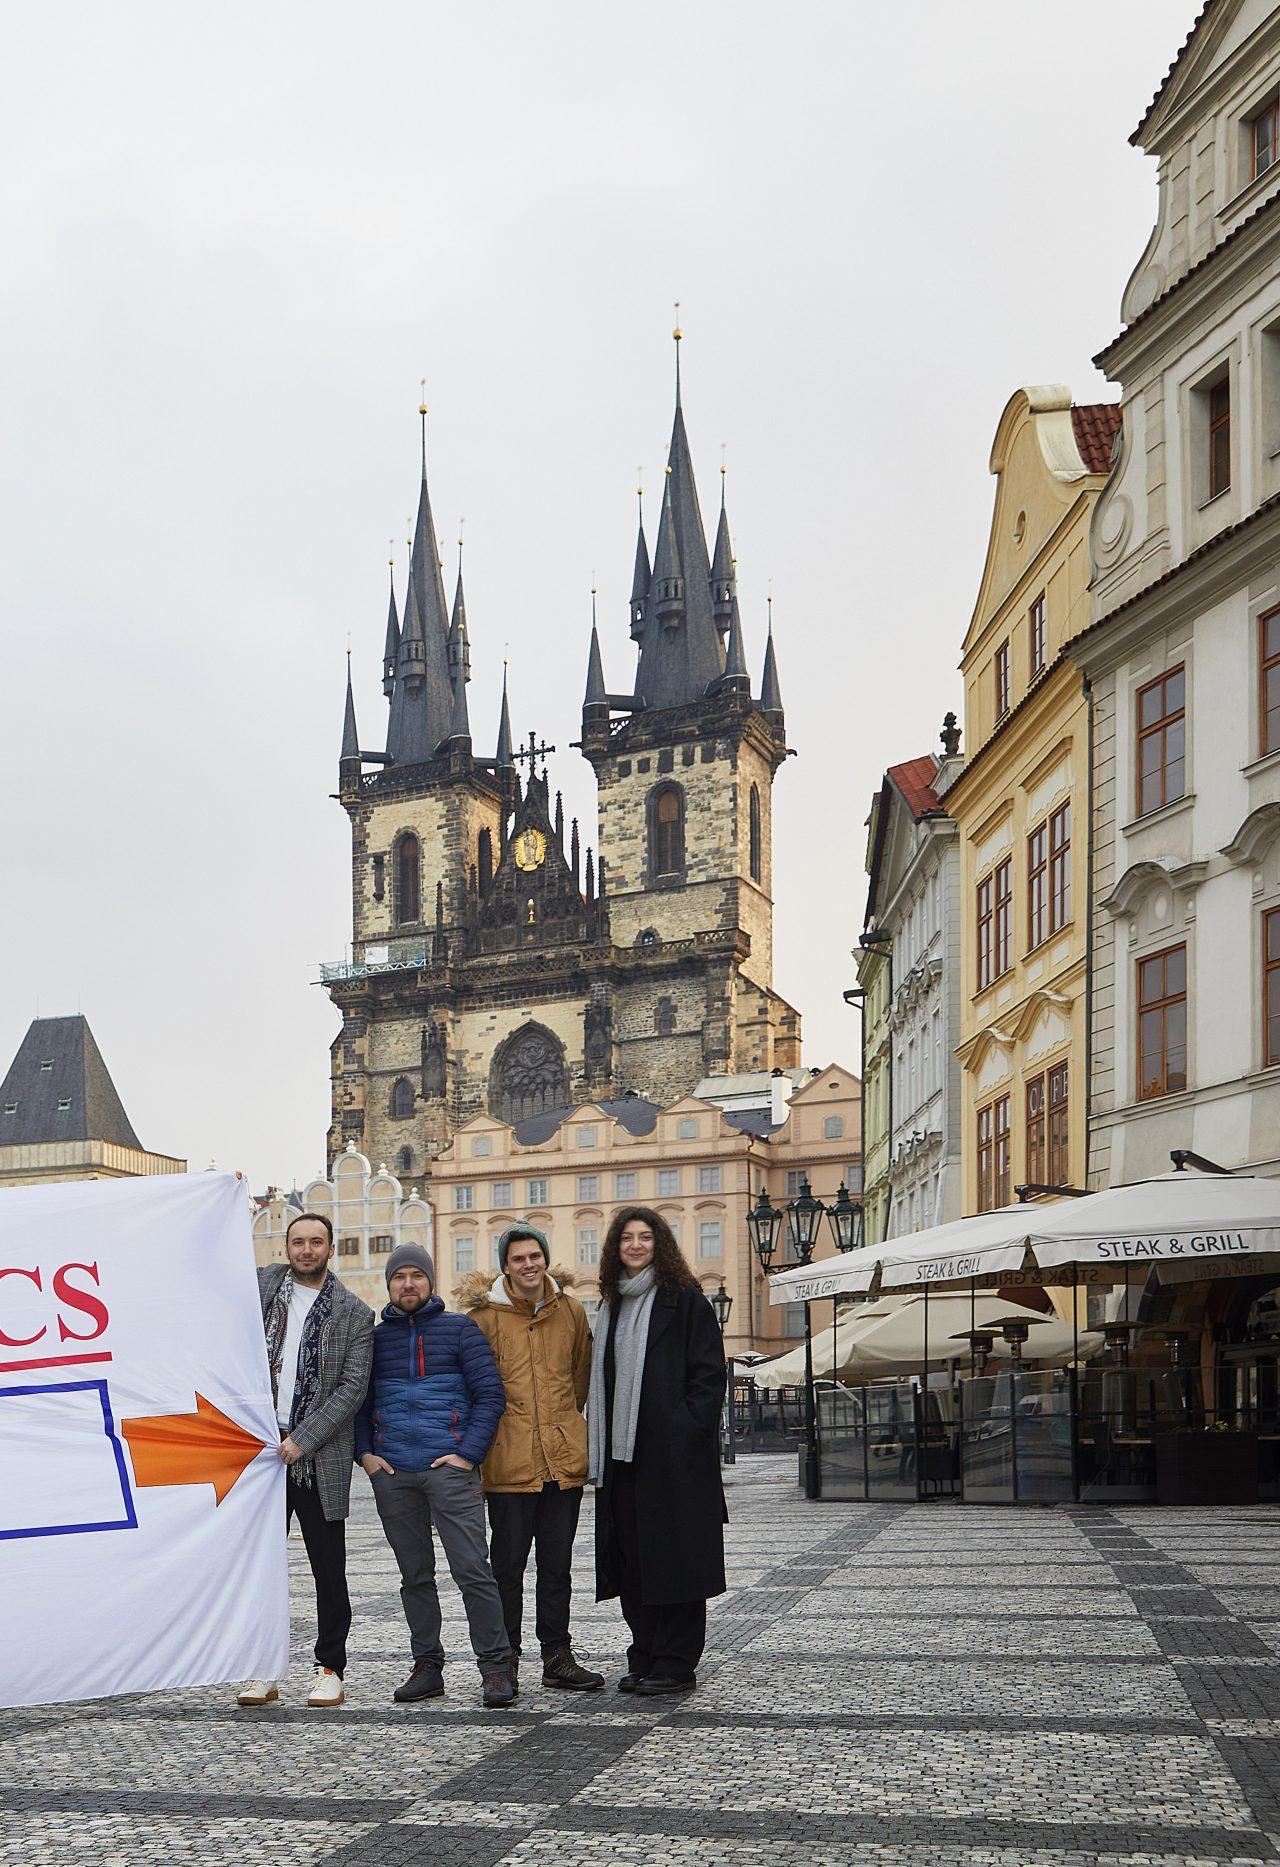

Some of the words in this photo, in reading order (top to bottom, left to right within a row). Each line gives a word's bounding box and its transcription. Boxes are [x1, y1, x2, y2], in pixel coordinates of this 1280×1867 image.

[1097, 1239, 1163, 1258] STEAK
[1170, 1238, 1185, 1254] &
[1190, 1233, 1250, 1252] GRILL
[916, 1262, 947, 1280] STEAK
[948, 1261, 954, 1277] &
[957, 1257, 981, 1275] GRILL
